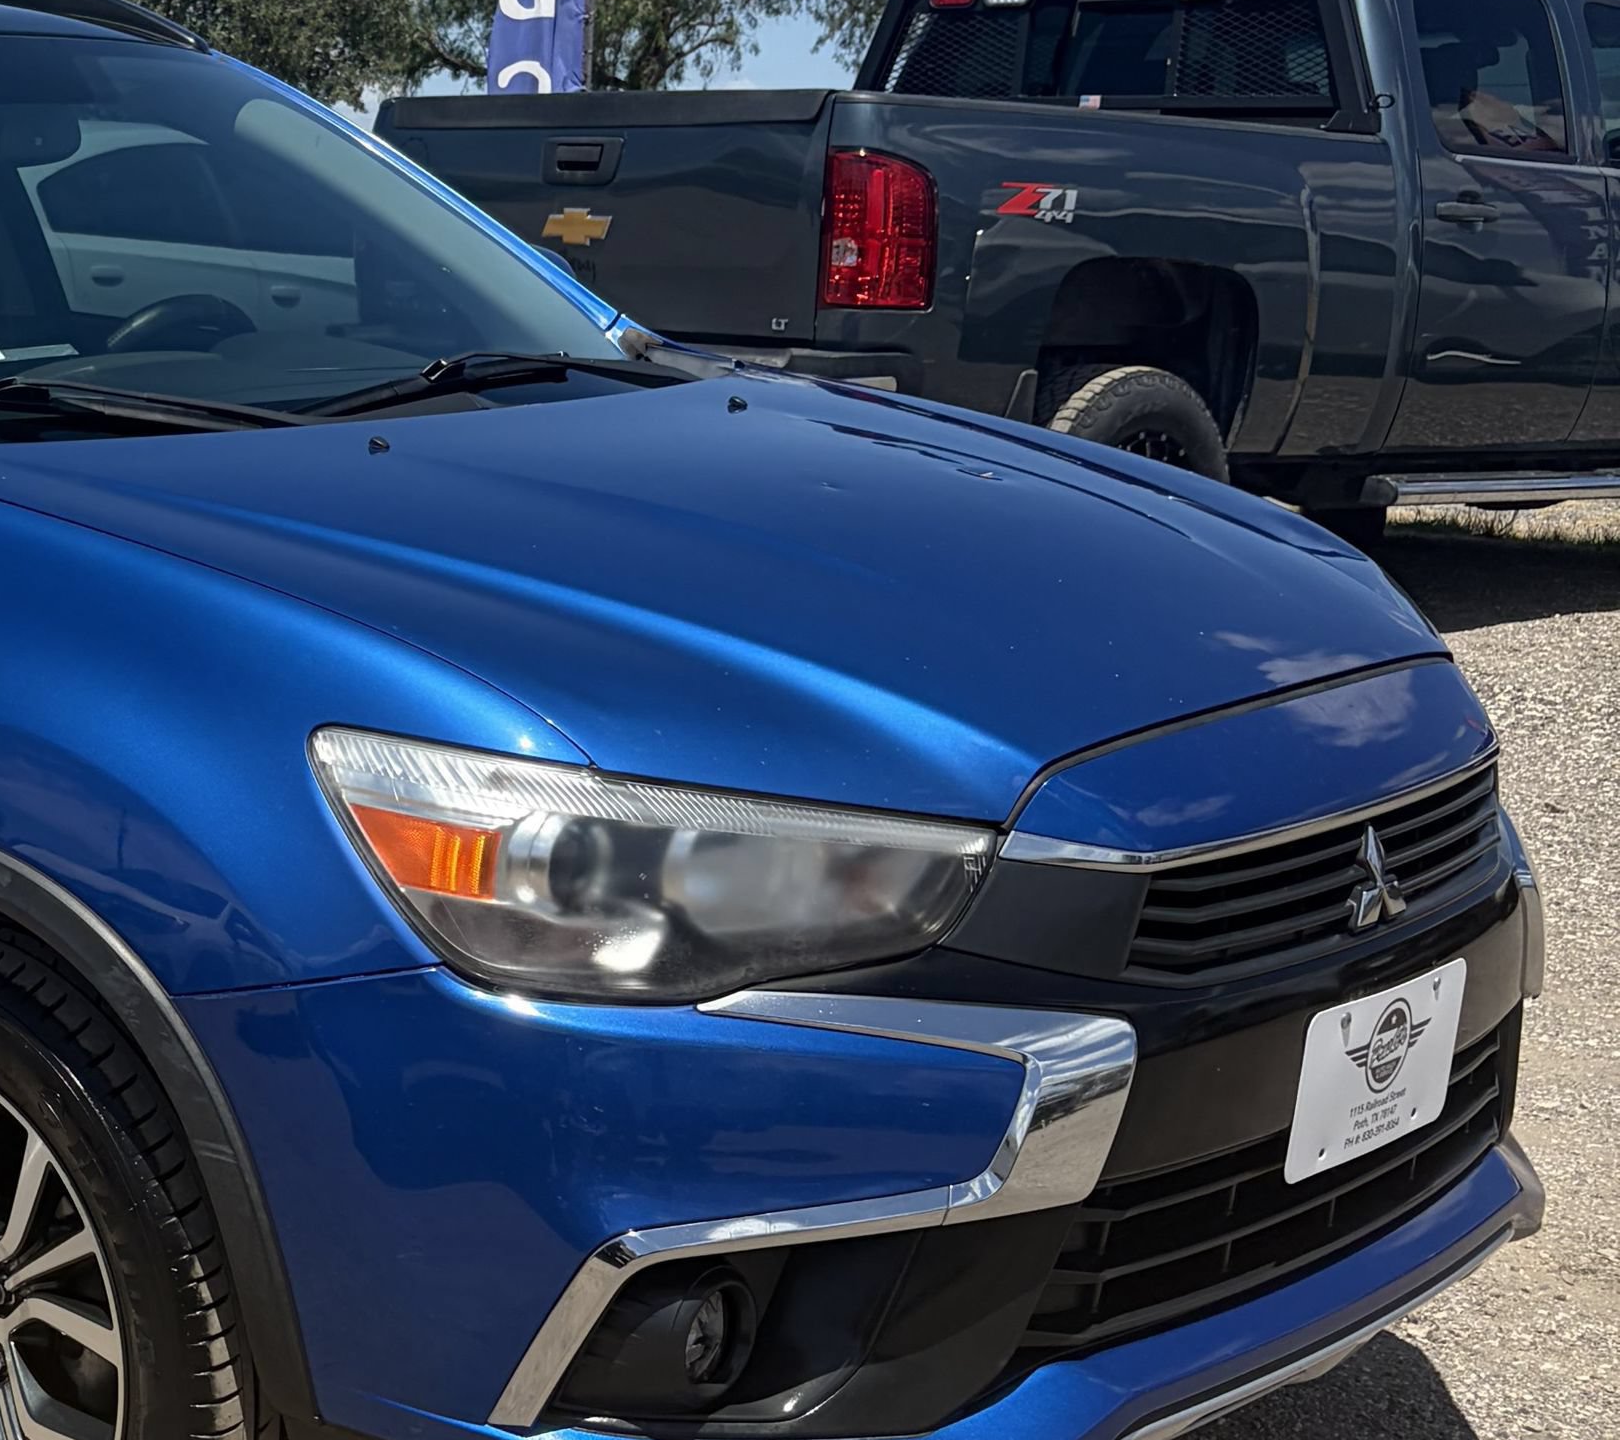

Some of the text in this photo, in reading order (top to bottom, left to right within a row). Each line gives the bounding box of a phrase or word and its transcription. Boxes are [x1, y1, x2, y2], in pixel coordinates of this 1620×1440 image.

[996, 181, 1078, 215] Z71
[771, 317, 789, 331] LT
[1371, 1112, 1379, 1123] TX
